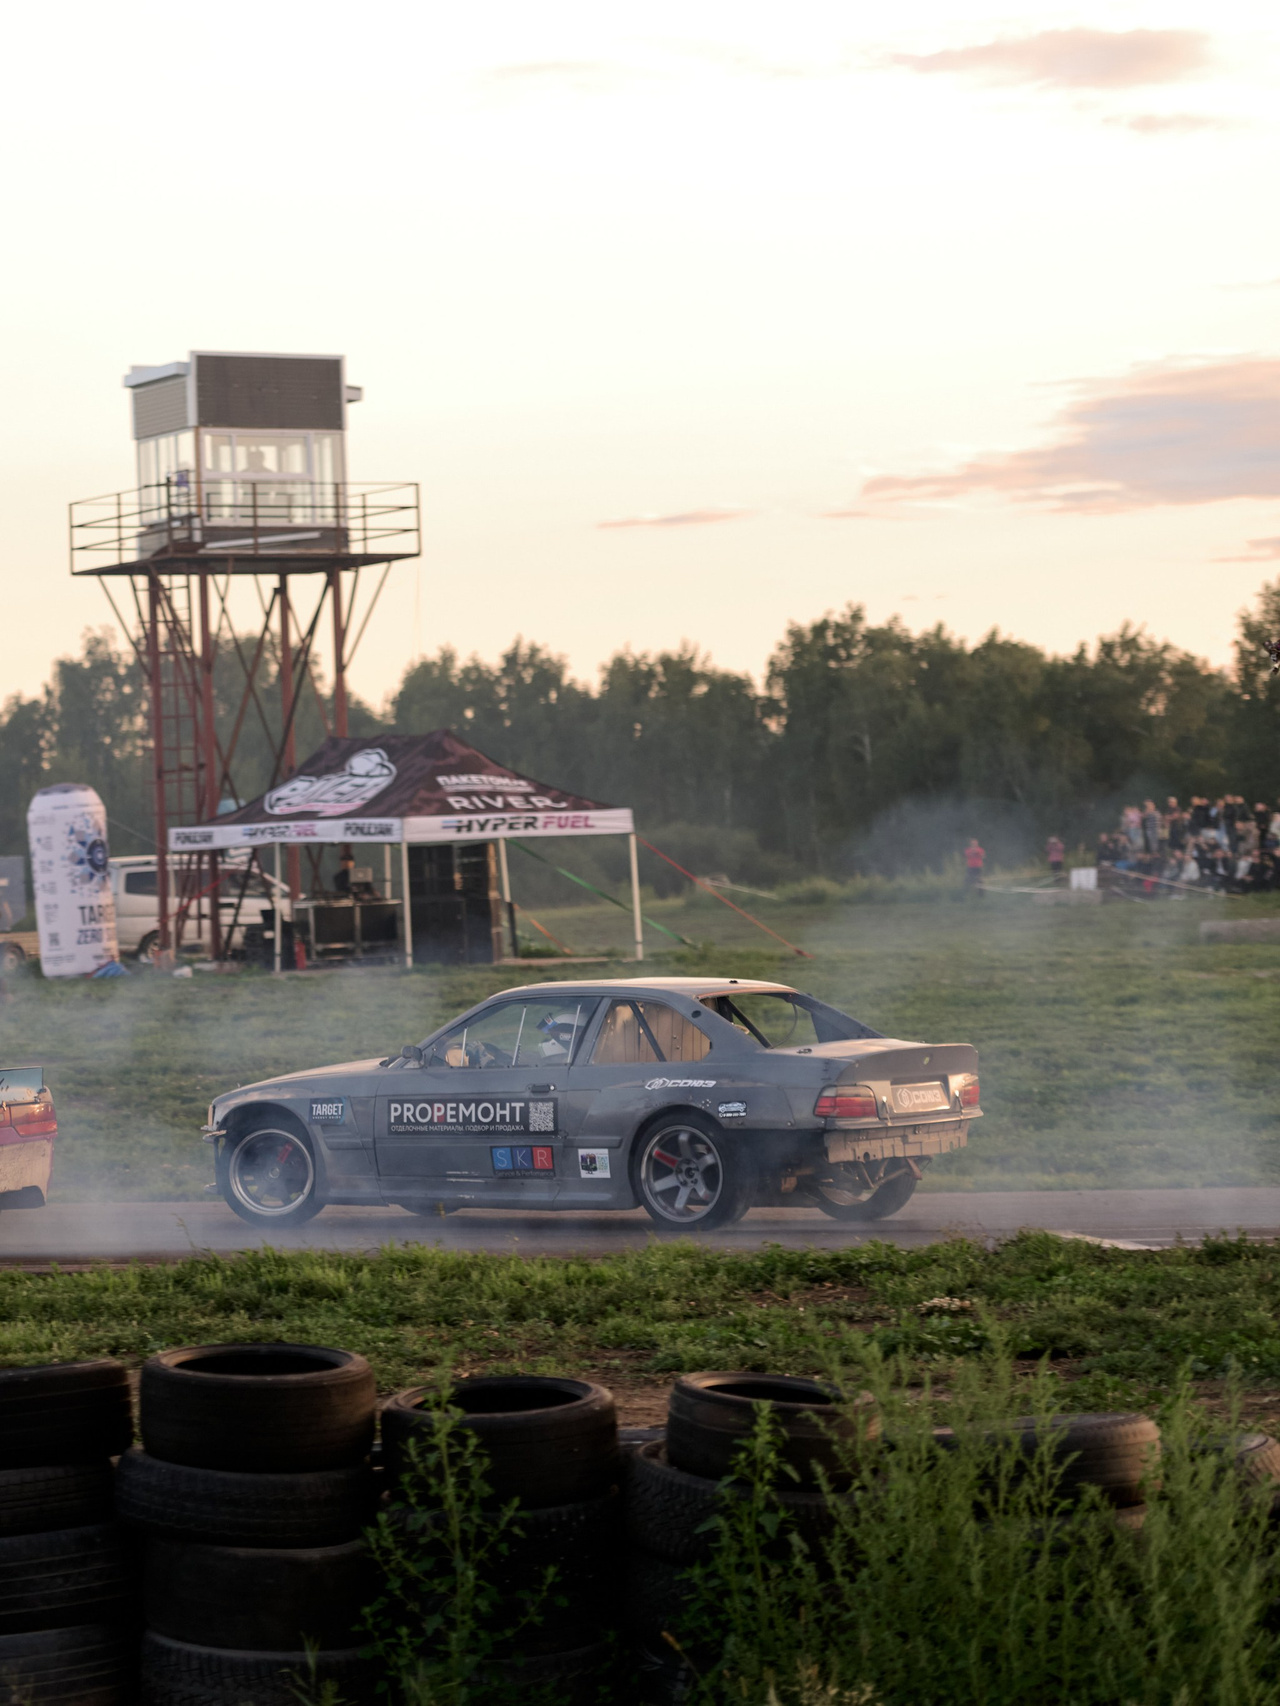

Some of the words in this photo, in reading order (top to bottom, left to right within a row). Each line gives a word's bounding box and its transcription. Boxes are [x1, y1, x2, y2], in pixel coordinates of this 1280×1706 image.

[446, 795, 569, 810] RIVER
[448, 816, 538, 833] HYPER
[541, 815, 596, 829] FUEL
[311, 1103, 343, 1116] TARGET
[465, 1124, 489, 1132] ПОДБОР
[495, 1124, 524, 1132] ПРОДАЖА
[496, 1149, 549, 1168] SKR
